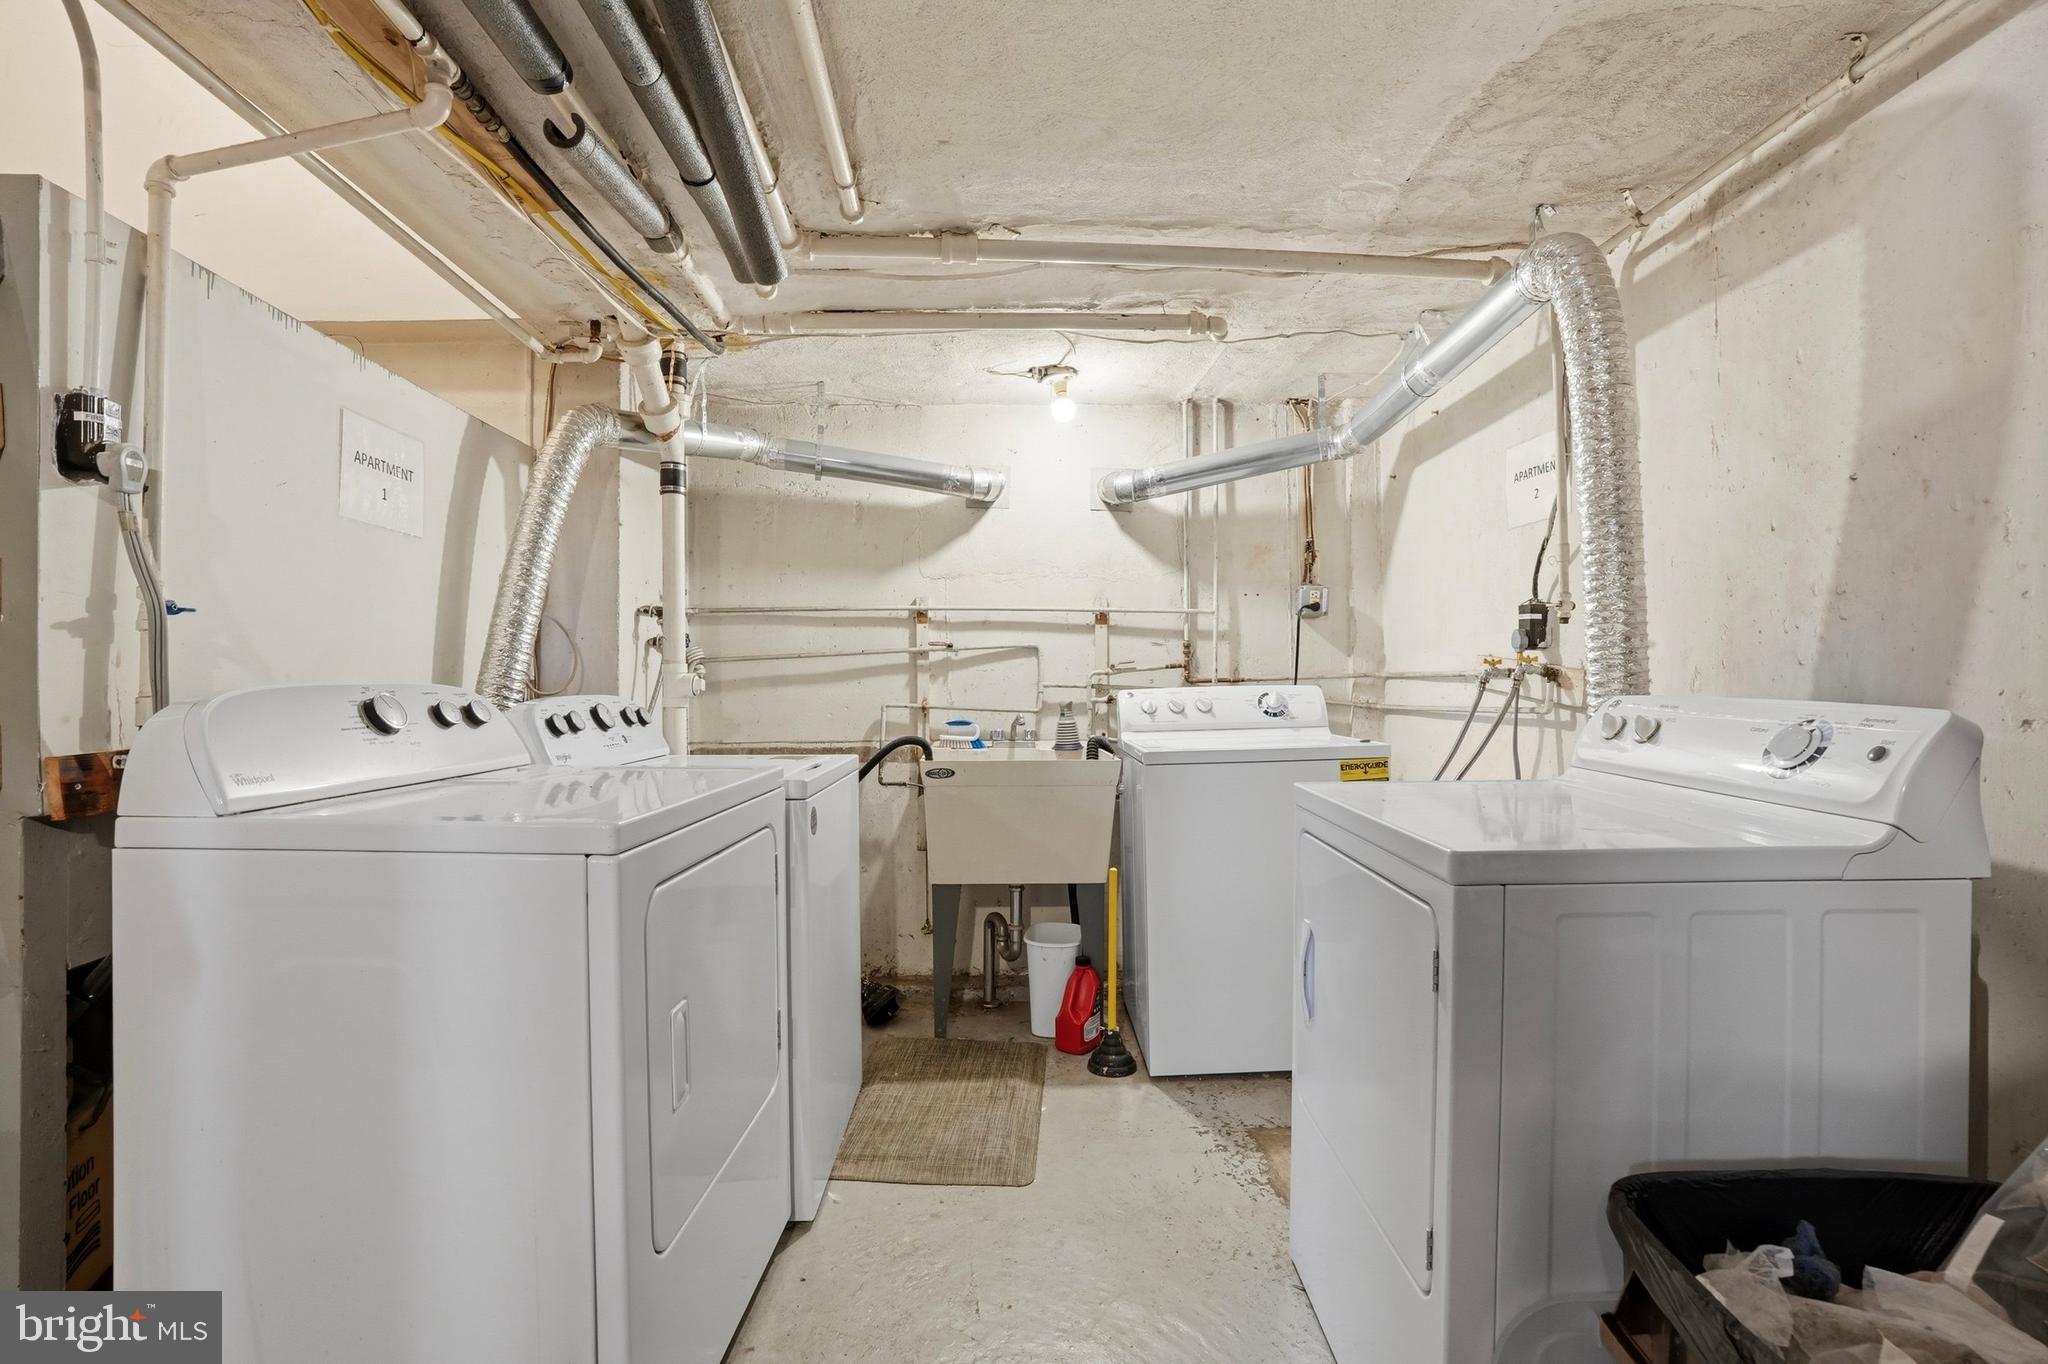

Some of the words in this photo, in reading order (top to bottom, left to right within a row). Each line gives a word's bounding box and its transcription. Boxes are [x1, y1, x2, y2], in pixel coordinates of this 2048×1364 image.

[85, 413, 105, 422] FIRS
[353, 450, 414, 482] APARTMENT
[1513, 460, 1556, 484] APARTMEN
[381, 487, 388, 501] 1
[1534, 487, 1540, 500] 2
[69, 1177, 100, 1219] Floor
